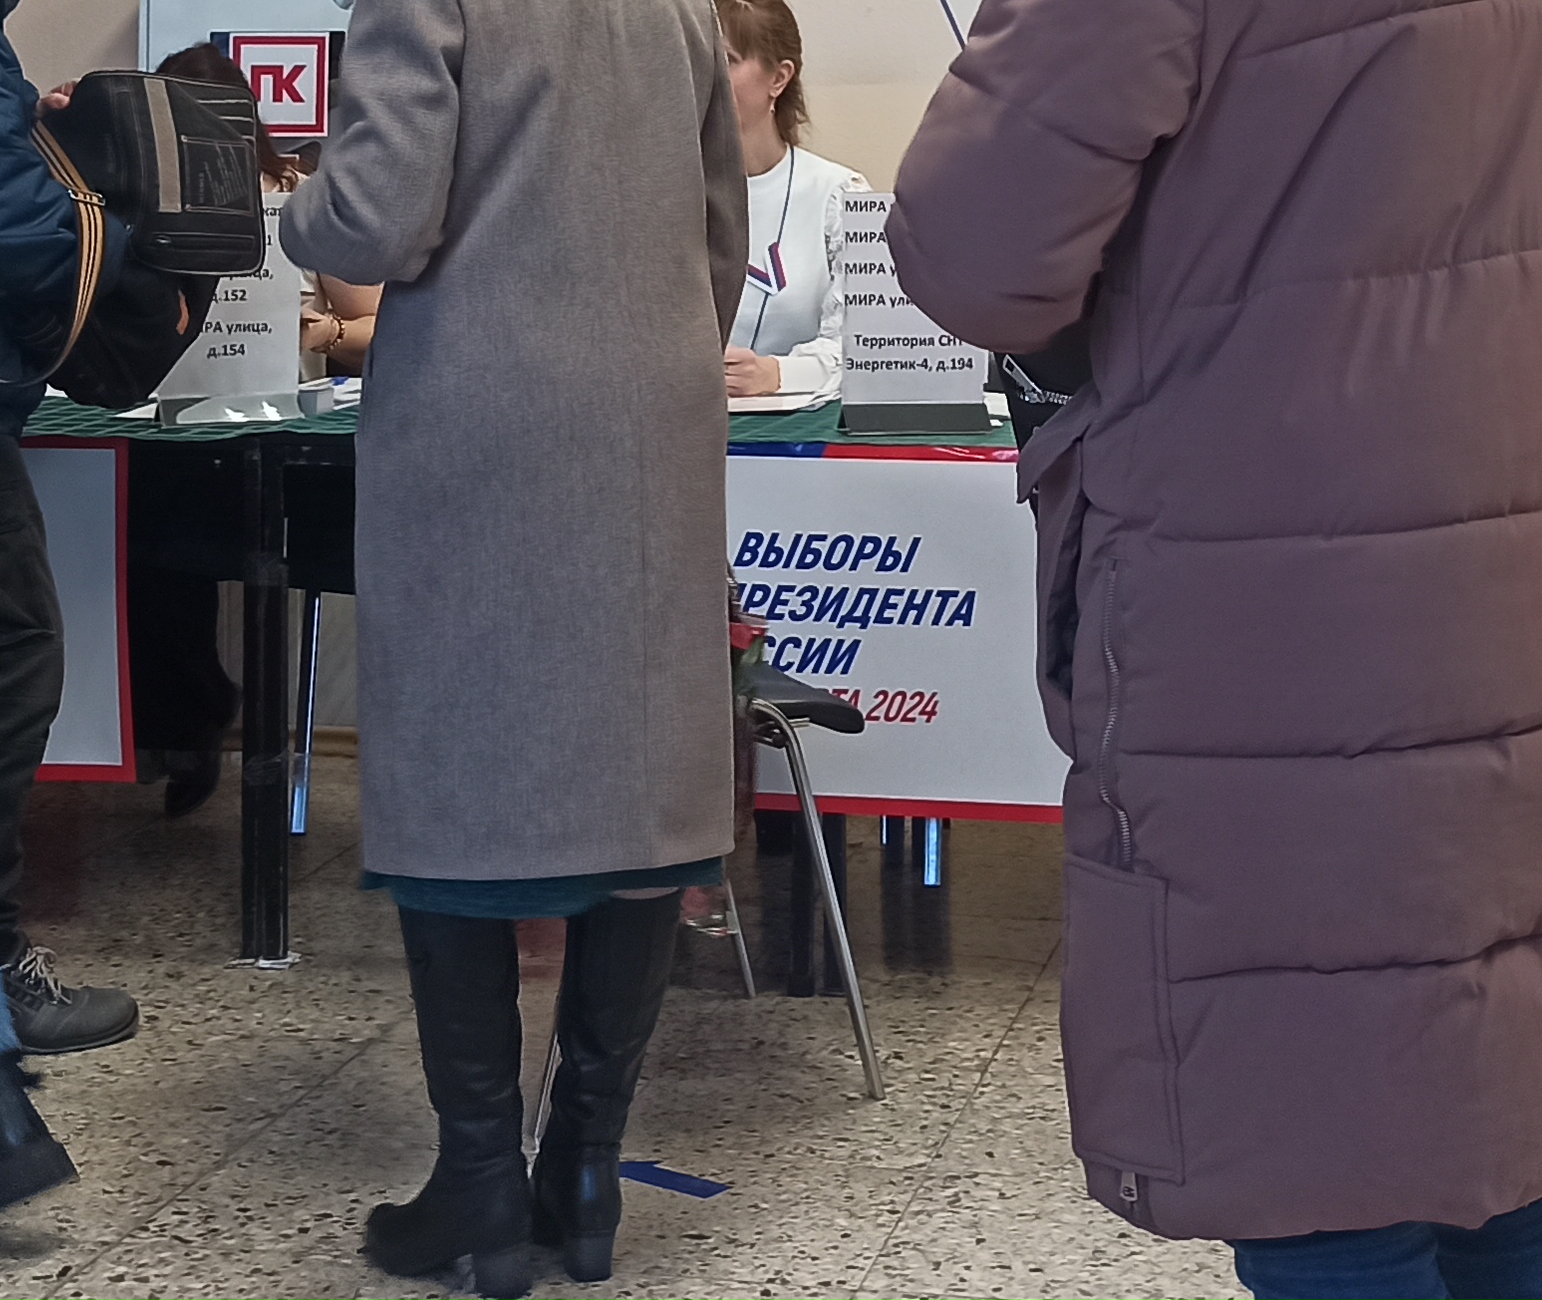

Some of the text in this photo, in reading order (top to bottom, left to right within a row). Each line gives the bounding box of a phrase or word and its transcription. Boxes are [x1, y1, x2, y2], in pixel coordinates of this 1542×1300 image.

[250, 64, 307, 103] ПК
[845, 200, 887, 212] МИРА
[845, 231, 887, 243] МИРА
[845, 262, 887, 275] МИРА
[844, 293, 886, 306] МИРА
[226, 322, 272, 335] улица,
[854, 334, 935, 349] Территория
[206, 343, 246, 359] д.154
[845, 357, 974, 372] Энергетик-4, д.194
[733, 531, 922, 573] ВЫБОРЫ
[763, 635, 862, 675] СИИ
[865, 689, 940, 723] 2024
